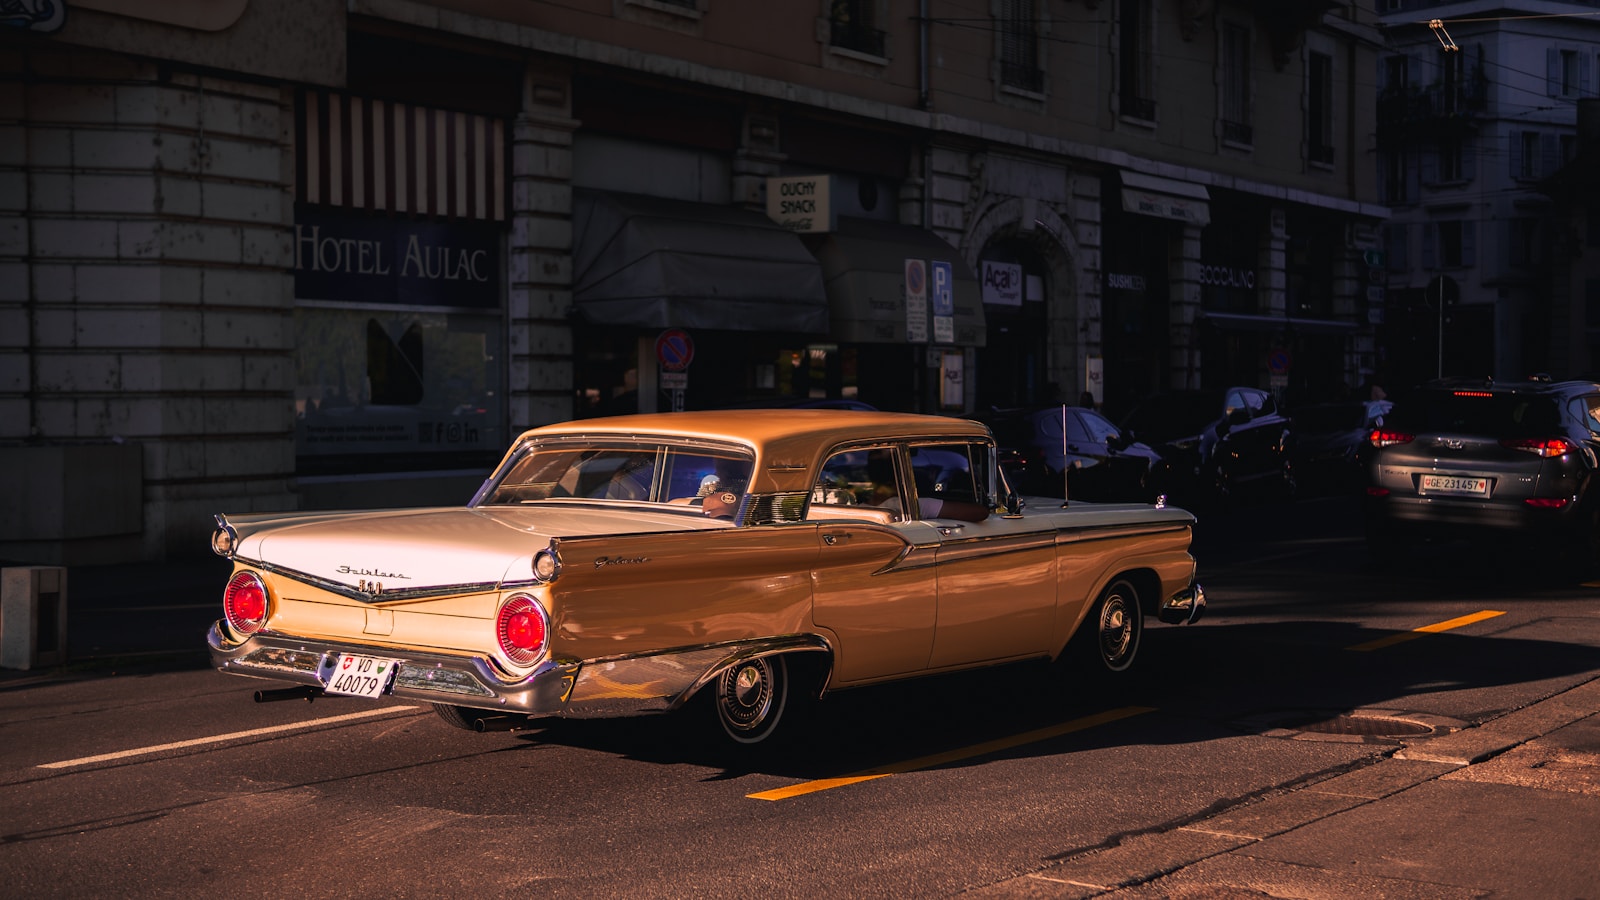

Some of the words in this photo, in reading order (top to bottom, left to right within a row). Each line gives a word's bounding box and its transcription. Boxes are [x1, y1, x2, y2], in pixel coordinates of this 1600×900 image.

[781, 182, 816, 196] OUCHY
[781, 200, 816, 214] SNACK
[295, 224, 390, 275] HOTEL
[400, 234, 488, 282] AULAC
[935, 266, 946, 295] P
[1200, 264, 1255, 289] BOCCALINO
[336, 565, 411, 580] Fairlane
[357, 658, 373, 673] VD
[334, 673, 378, 695] 40079
